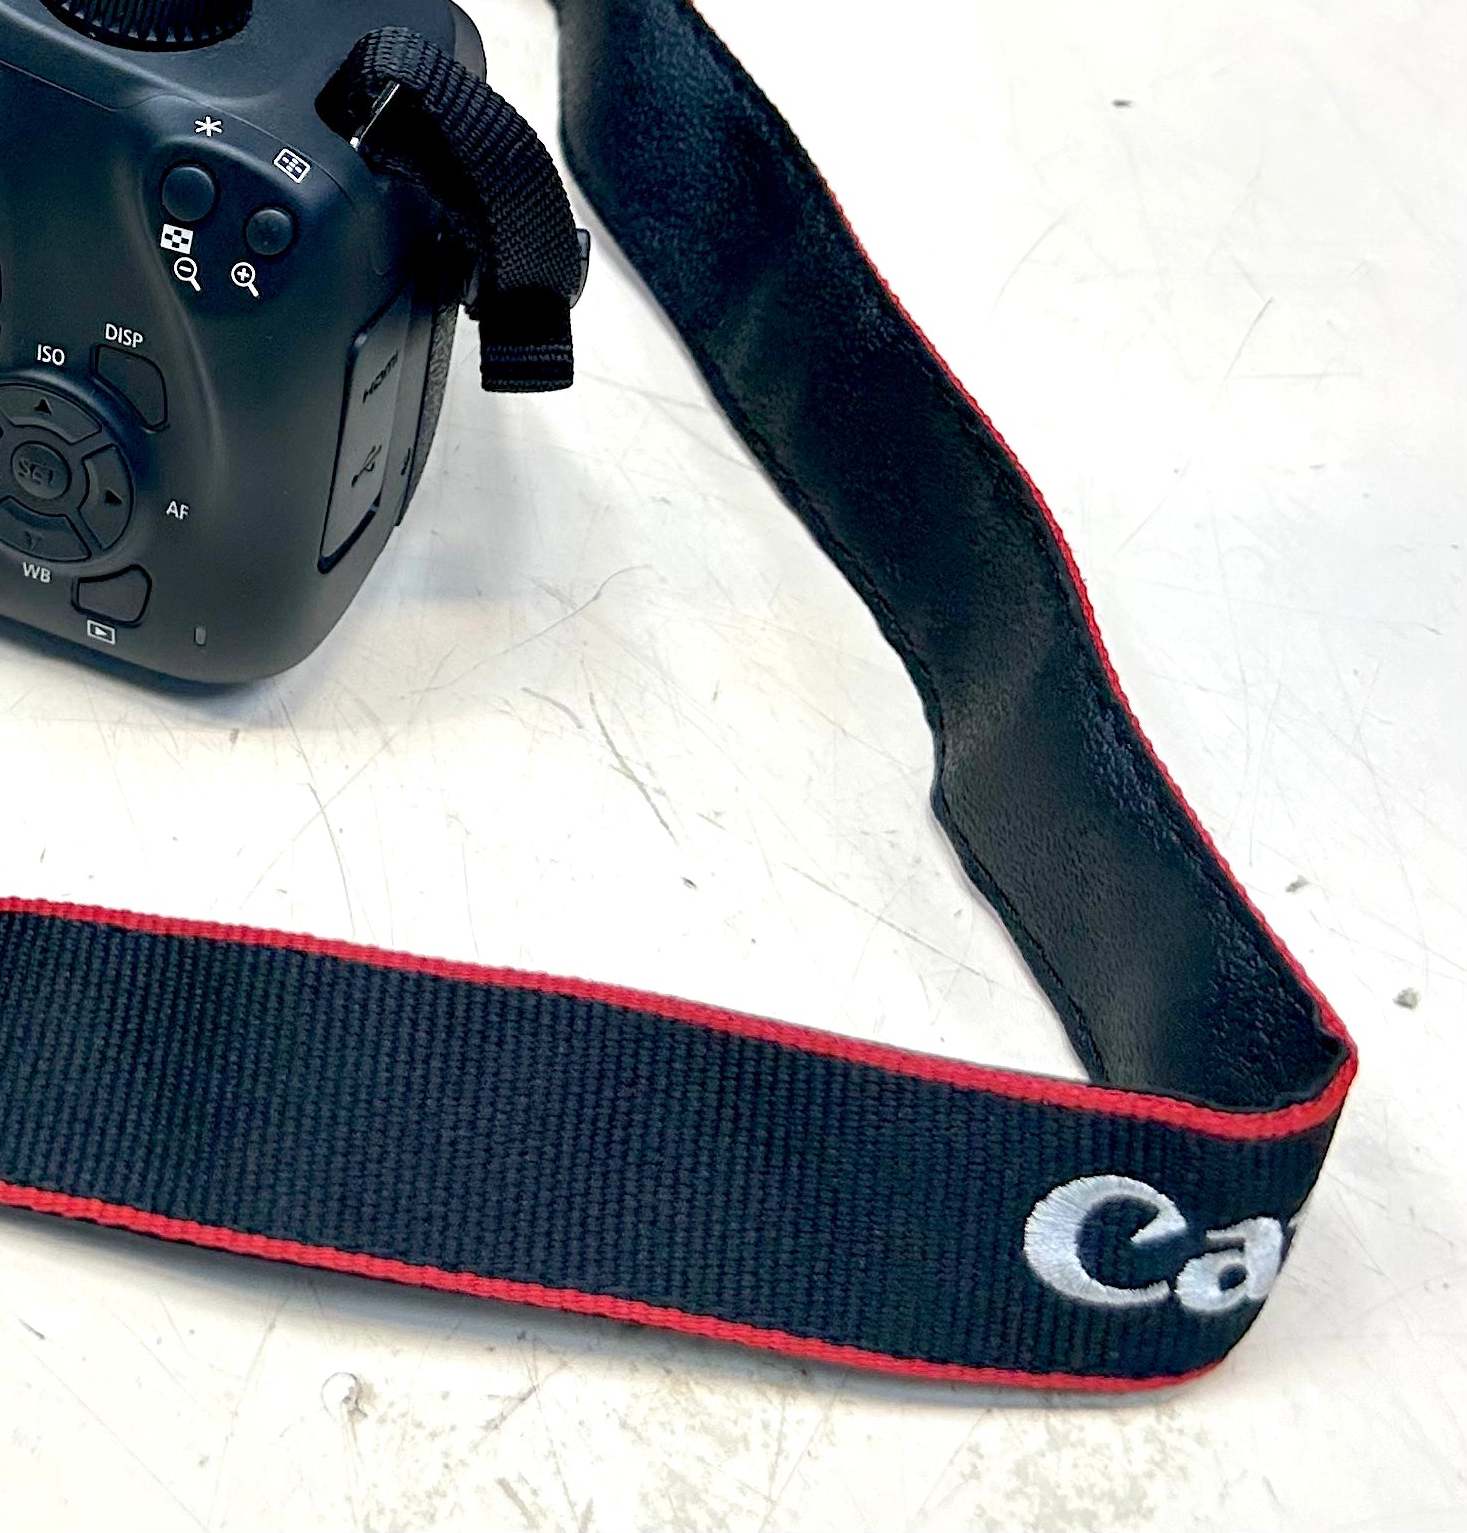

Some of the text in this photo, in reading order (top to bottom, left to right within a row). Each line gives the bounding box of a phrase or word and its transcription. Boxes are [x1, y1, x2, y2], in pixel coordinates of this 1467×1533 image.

[105, 323, 144, 348] DISP
[36, 344, 65, 366] ISO
[165, 500, 190, 520] AF
[22, 561, 52, 583] WB
[1023, 1174, 1296, 1313] Ca
